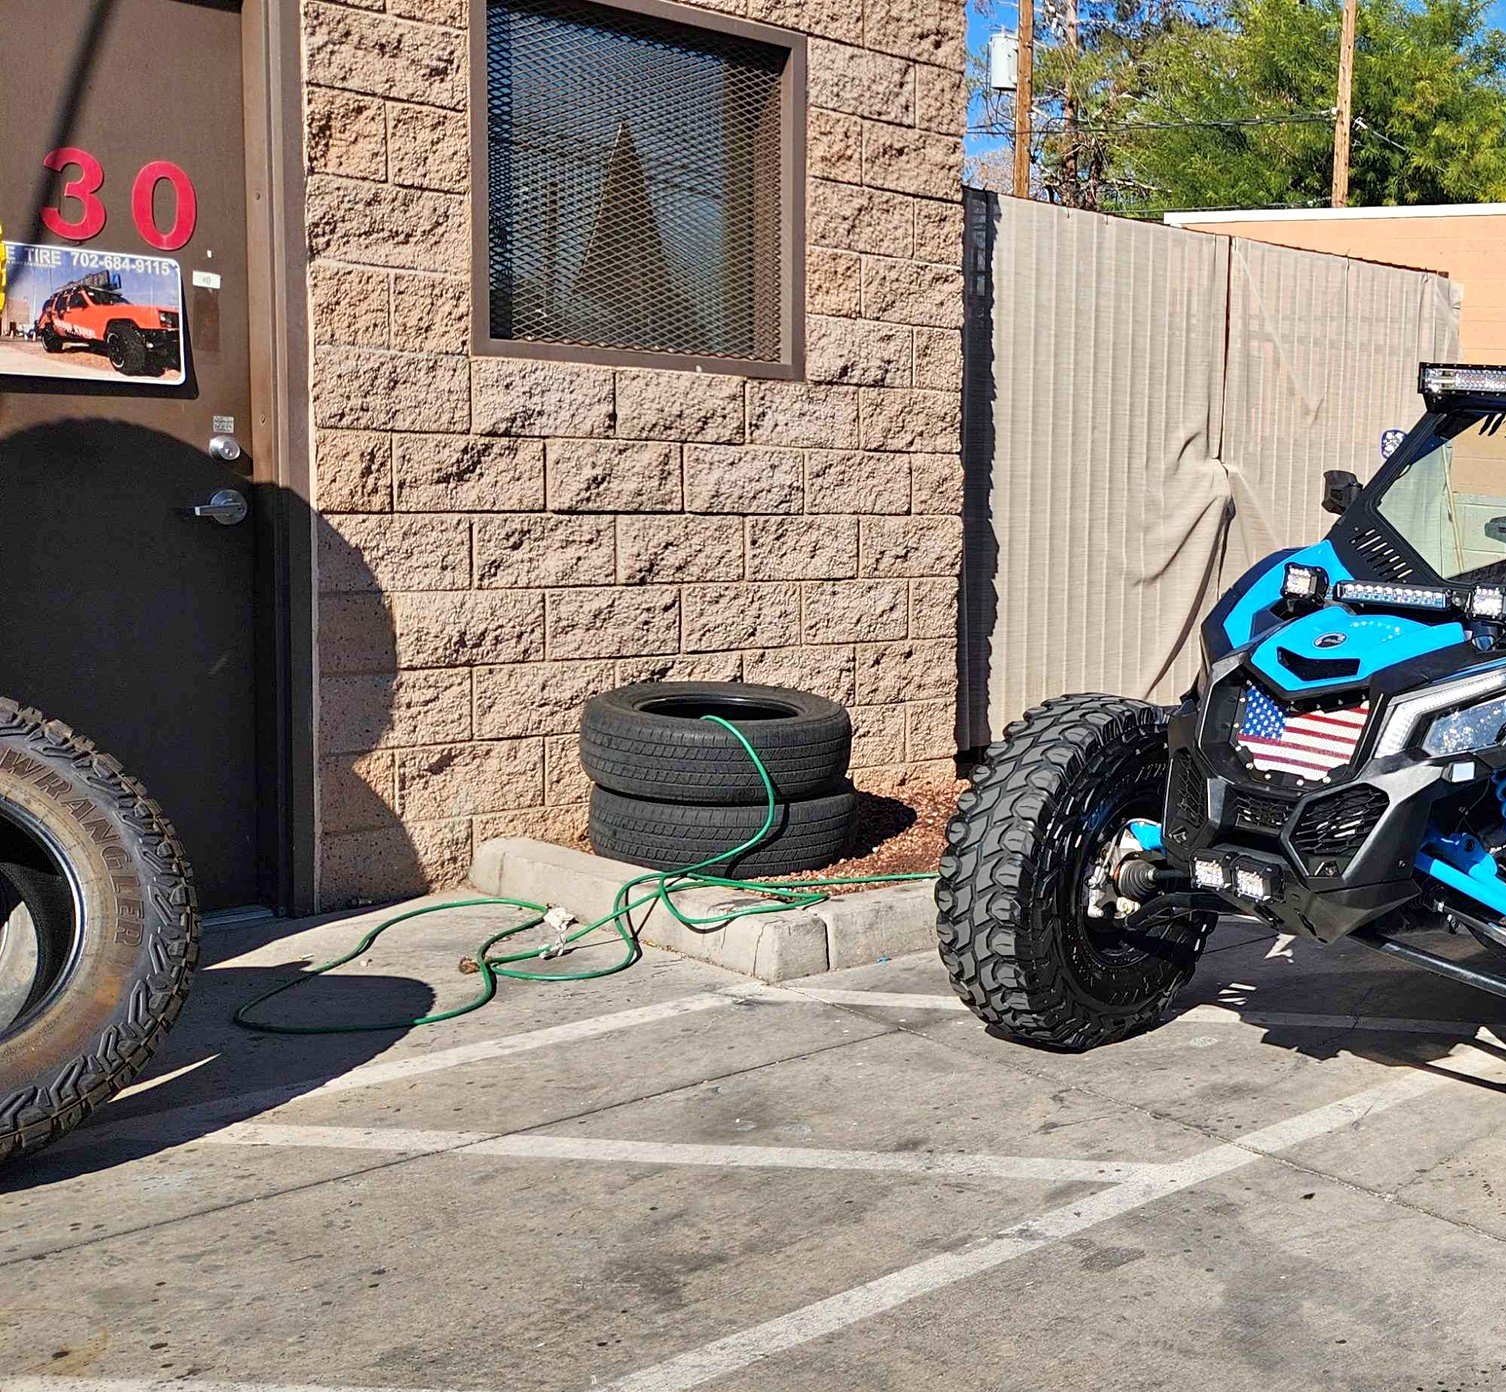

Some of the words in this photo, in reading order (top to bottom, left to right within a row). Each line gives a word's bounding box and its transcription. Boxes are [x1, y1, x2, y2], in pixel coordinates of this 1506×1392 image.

[40, 147, 197, 251] 30
[24, 247, 62, 266] TIRE
[71, 251, 171, 276] 702-684-9115
[0, 748, 145, 948] WRANGLER
